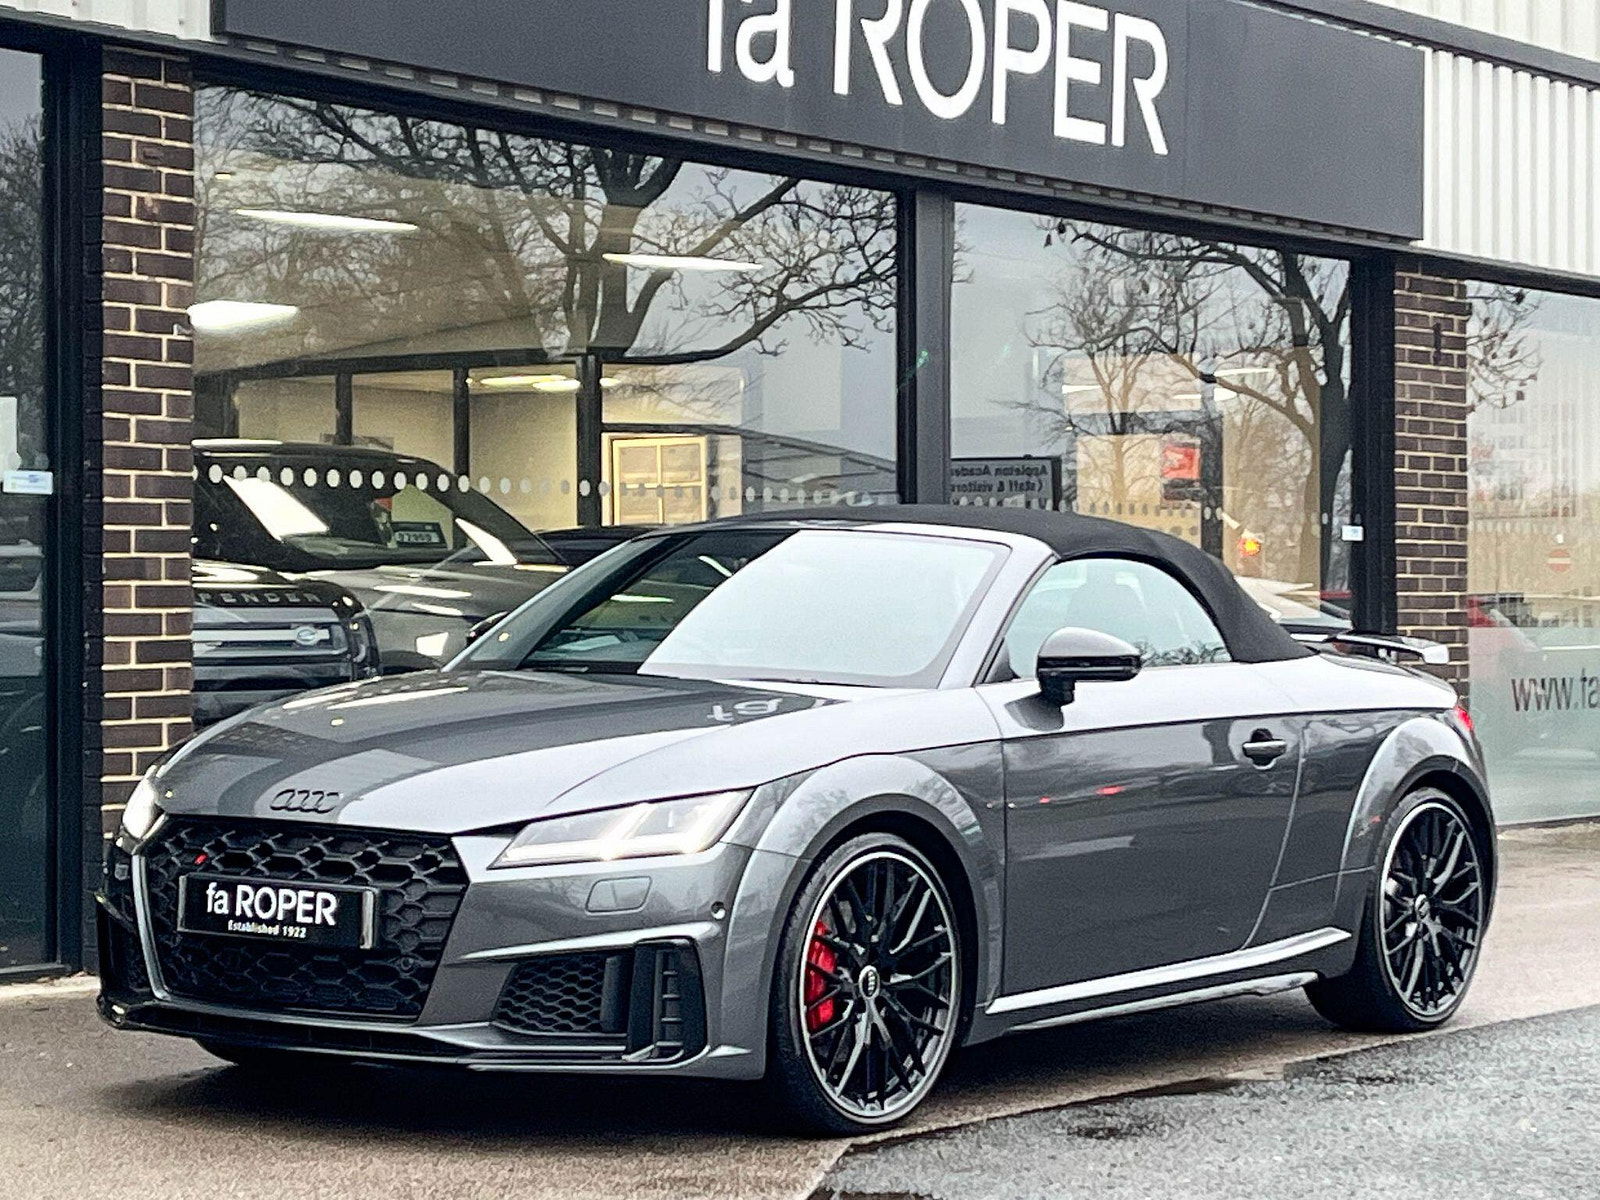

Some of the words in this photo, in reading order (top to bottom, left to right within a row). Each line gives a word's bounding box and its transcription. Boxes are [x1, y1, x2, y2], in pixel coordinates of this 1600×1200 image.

[833, 0, 1168, 156] ROPER
[206, 881, 229, 915] fa
[236, 884, 339, 926] ROPER
[228, 919, 279, 936] Established
[283, 925, 307, 939] 1922
